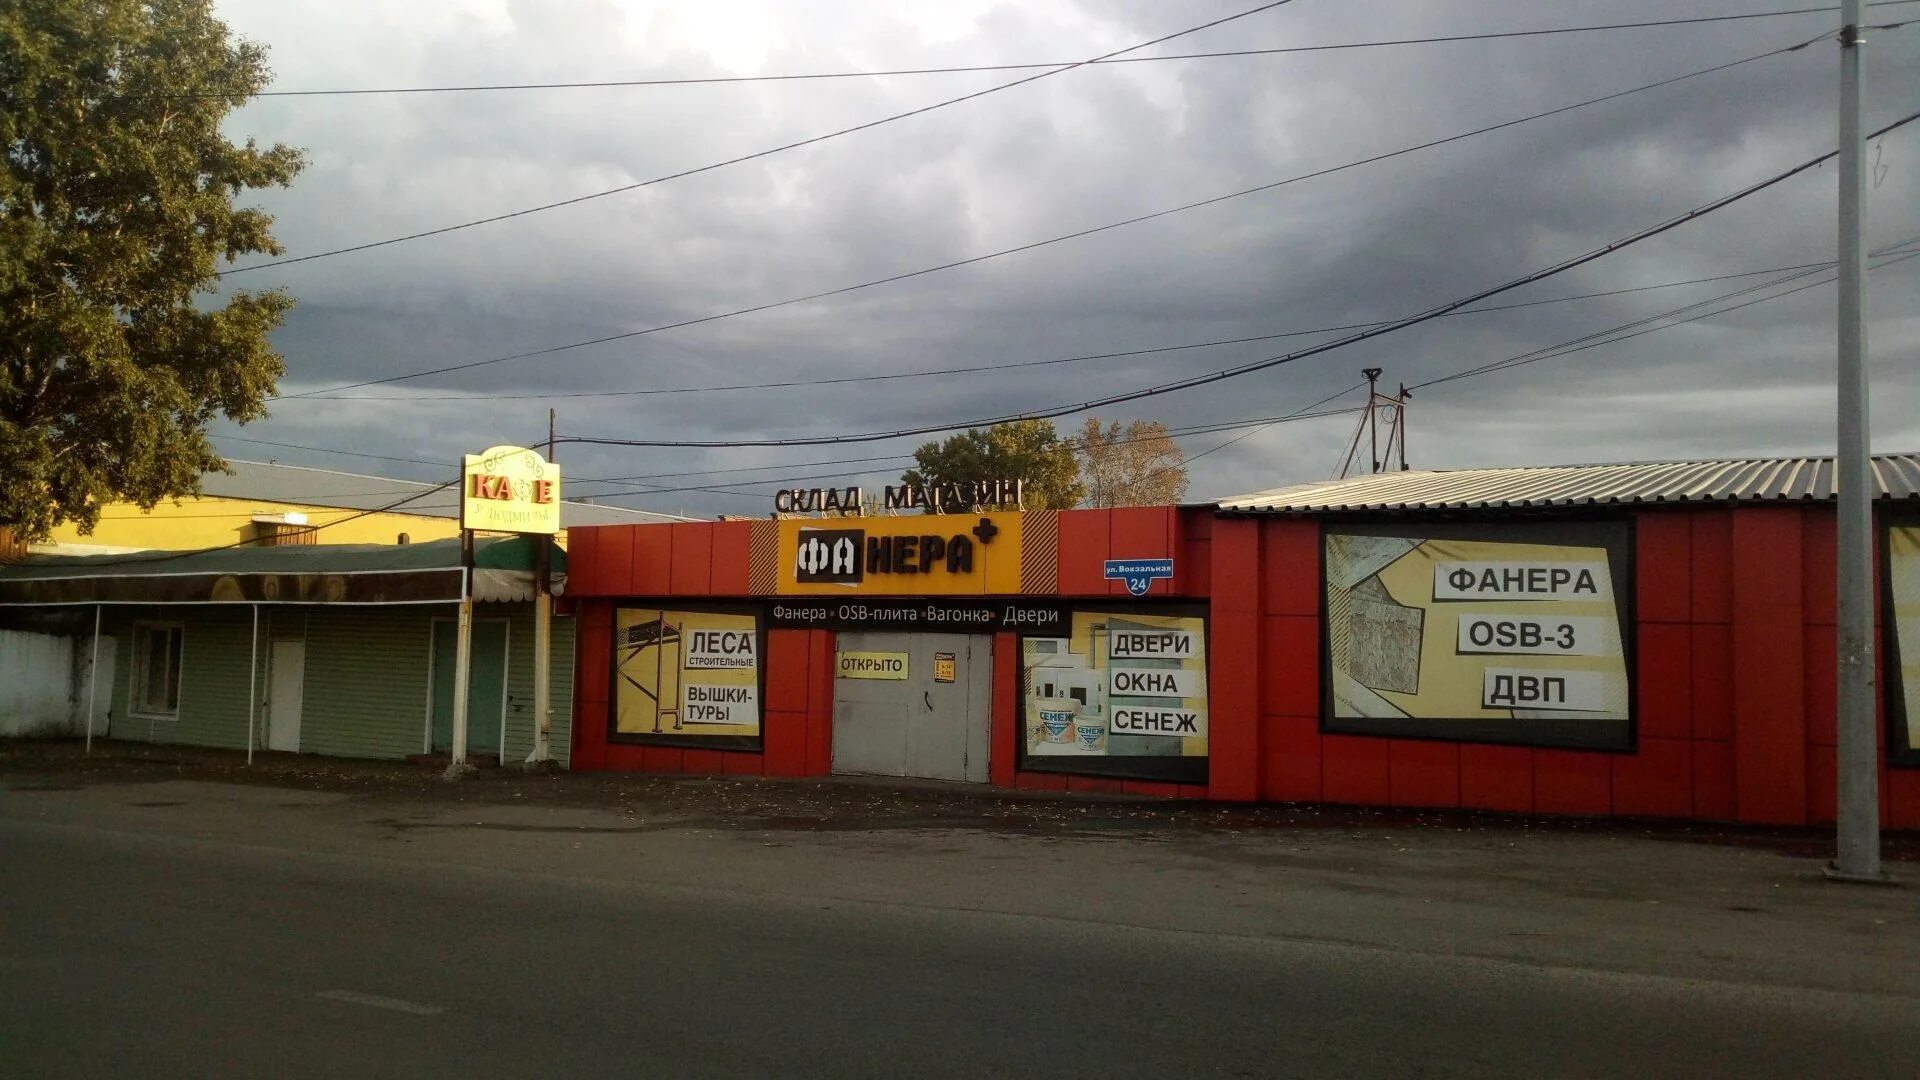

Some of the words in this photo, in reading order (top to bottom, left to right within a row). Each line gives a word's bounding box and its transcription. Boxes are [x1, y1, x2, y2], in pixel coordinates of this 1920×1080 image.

[775, 487, 862, 516] СКЛАД
[1131, 578, 1146, 590] 24
[1449, 569, 1597, 594] ФАНЕРА
[773, 605, 826, 622] Фанера
[839, 605, 917, 621] OSB-плита
[927, 606, 989, 625] Вагонка
[1003, 606, 1058, 625] Двери
[691, 632, 752, 654] ЛЕСА
[1115, 634, 1189, 654] ДВЕРИ
[1469, 621, 1575, 649] OSB-3
[689, 658, 754, 667] СТРОИТЕЛЬНЫЕ
[842, 658, 902, 671] ОТКРЫТО
[1115, 673, 1177, 692] ОКНА
[1490, 675, 1565, 704] ДВП
[688, 687, 752, 703] ВЫШКИ-
[687, 705, 729, 720] ТУРЫ
[1115, 711, 1197, 732] СЕНЕЖ
